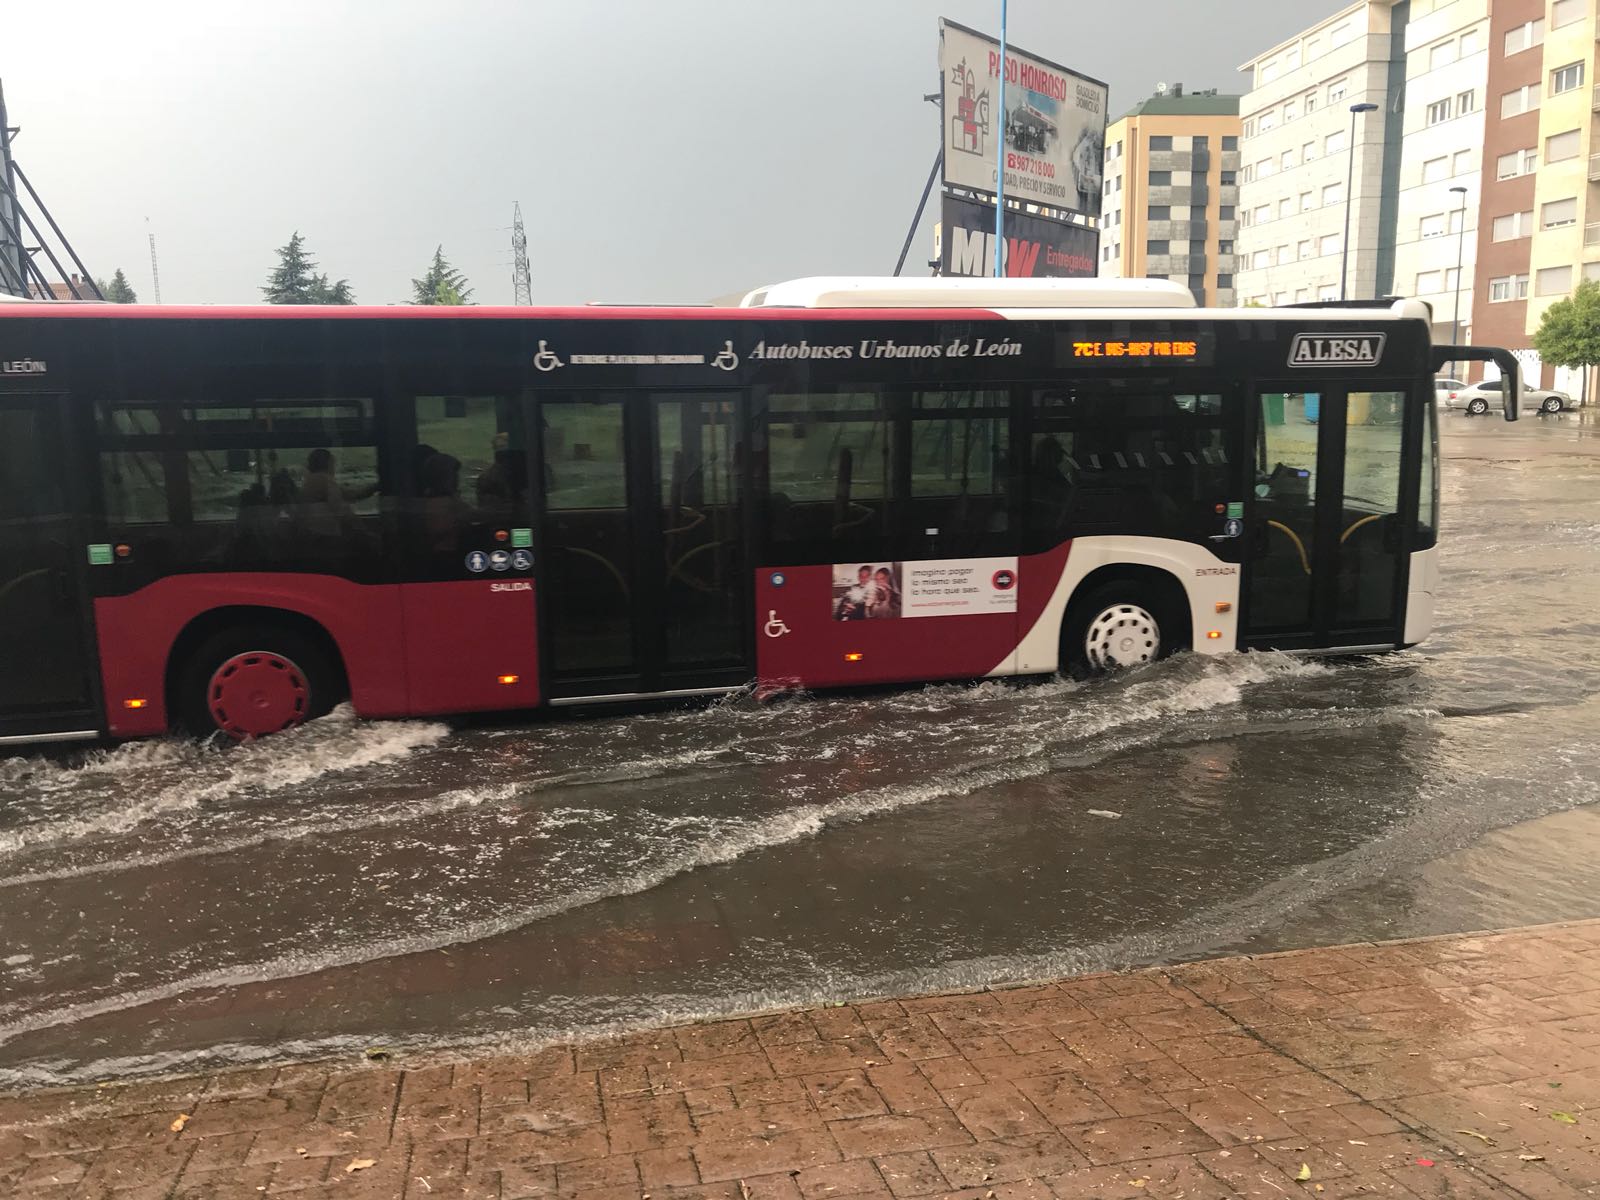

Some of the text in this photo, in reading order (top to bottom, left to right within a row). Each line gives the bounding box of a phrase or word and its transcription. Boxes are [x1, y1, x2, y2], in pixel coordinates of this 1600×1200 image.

[988, 51, 1067, 102] PASO HONROSO
[1016, 155, 1055, 179] 987 218 000
[1019, 178, 1038, 193] PRECIO
[1043, 182, 1066, 198] SERVICIO
[951, 226, 1093, 277] MRW Entregados
[748, 338, 1022, 359] Autobuses Urbanos de León
[1295, 339, 1374, 361] ALESA
[490, 582, 533, 593] SALIDA
